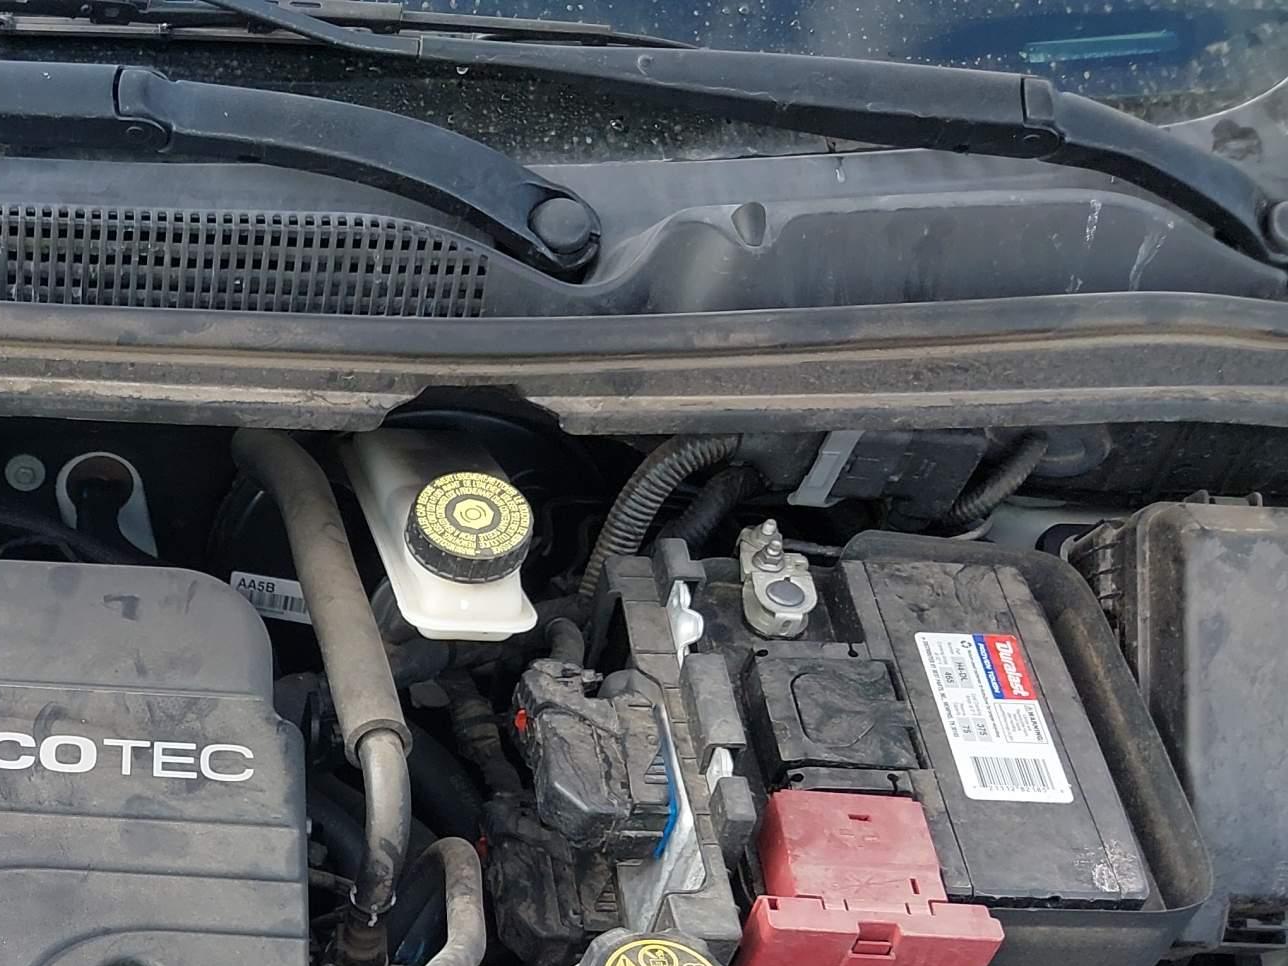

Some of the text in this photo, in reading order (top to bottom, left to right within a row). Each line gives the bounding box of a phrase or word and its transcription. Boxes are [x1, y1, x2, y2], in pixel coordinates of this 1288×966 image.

[237, 577, 275, 593] AA5B
[976, 642, 993, 670] PROVEN
[986, 670, 1001, 693] TOUGH
[993, 640, 1030, 697] Duralast
[974, 722, 988, 736] 375
